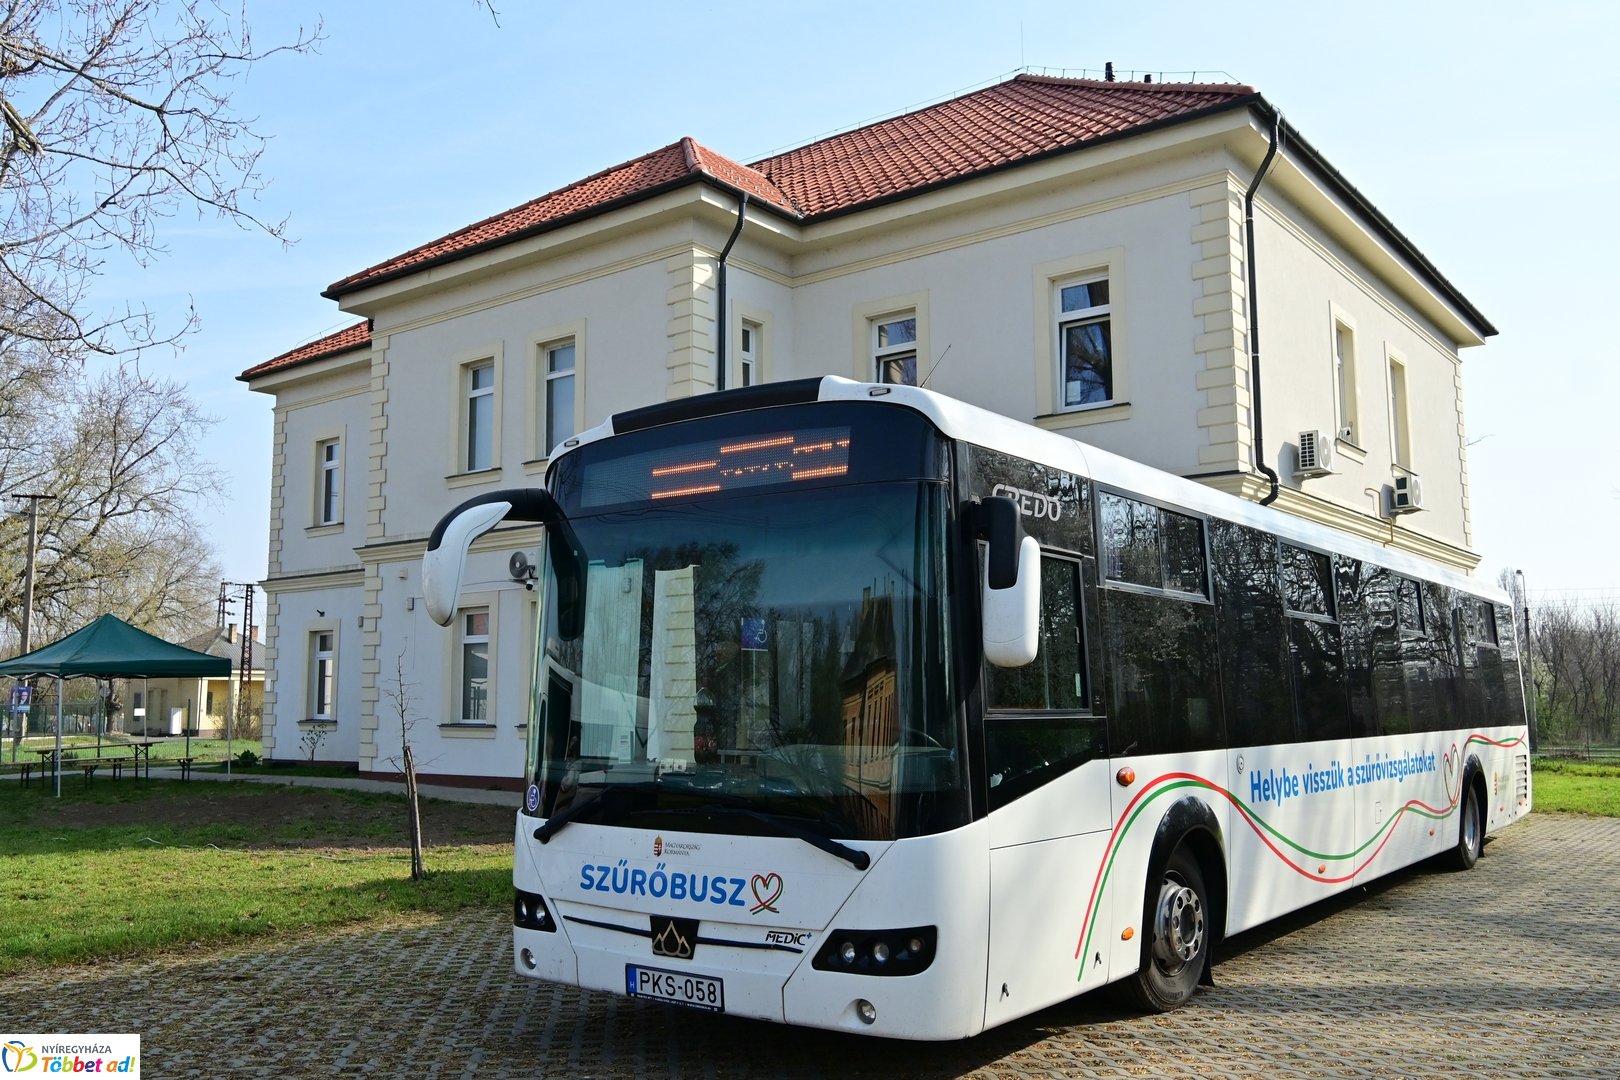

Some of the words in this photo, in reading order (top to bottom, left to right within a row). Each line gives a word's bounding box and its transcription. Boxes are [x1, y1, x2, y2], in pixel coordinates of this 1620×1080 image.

[1250, 767, 1299, 808] Helybe
[1302, 760, 1345, 795] visszük
[1346, 766, 1354, 787] a
[1355, 749, 1436, 783] szűrővizsgálatokat
[579, 858, 747, 907] SZŰRŐBUSZ
[639, 971, 717, 1004] PKS-058
